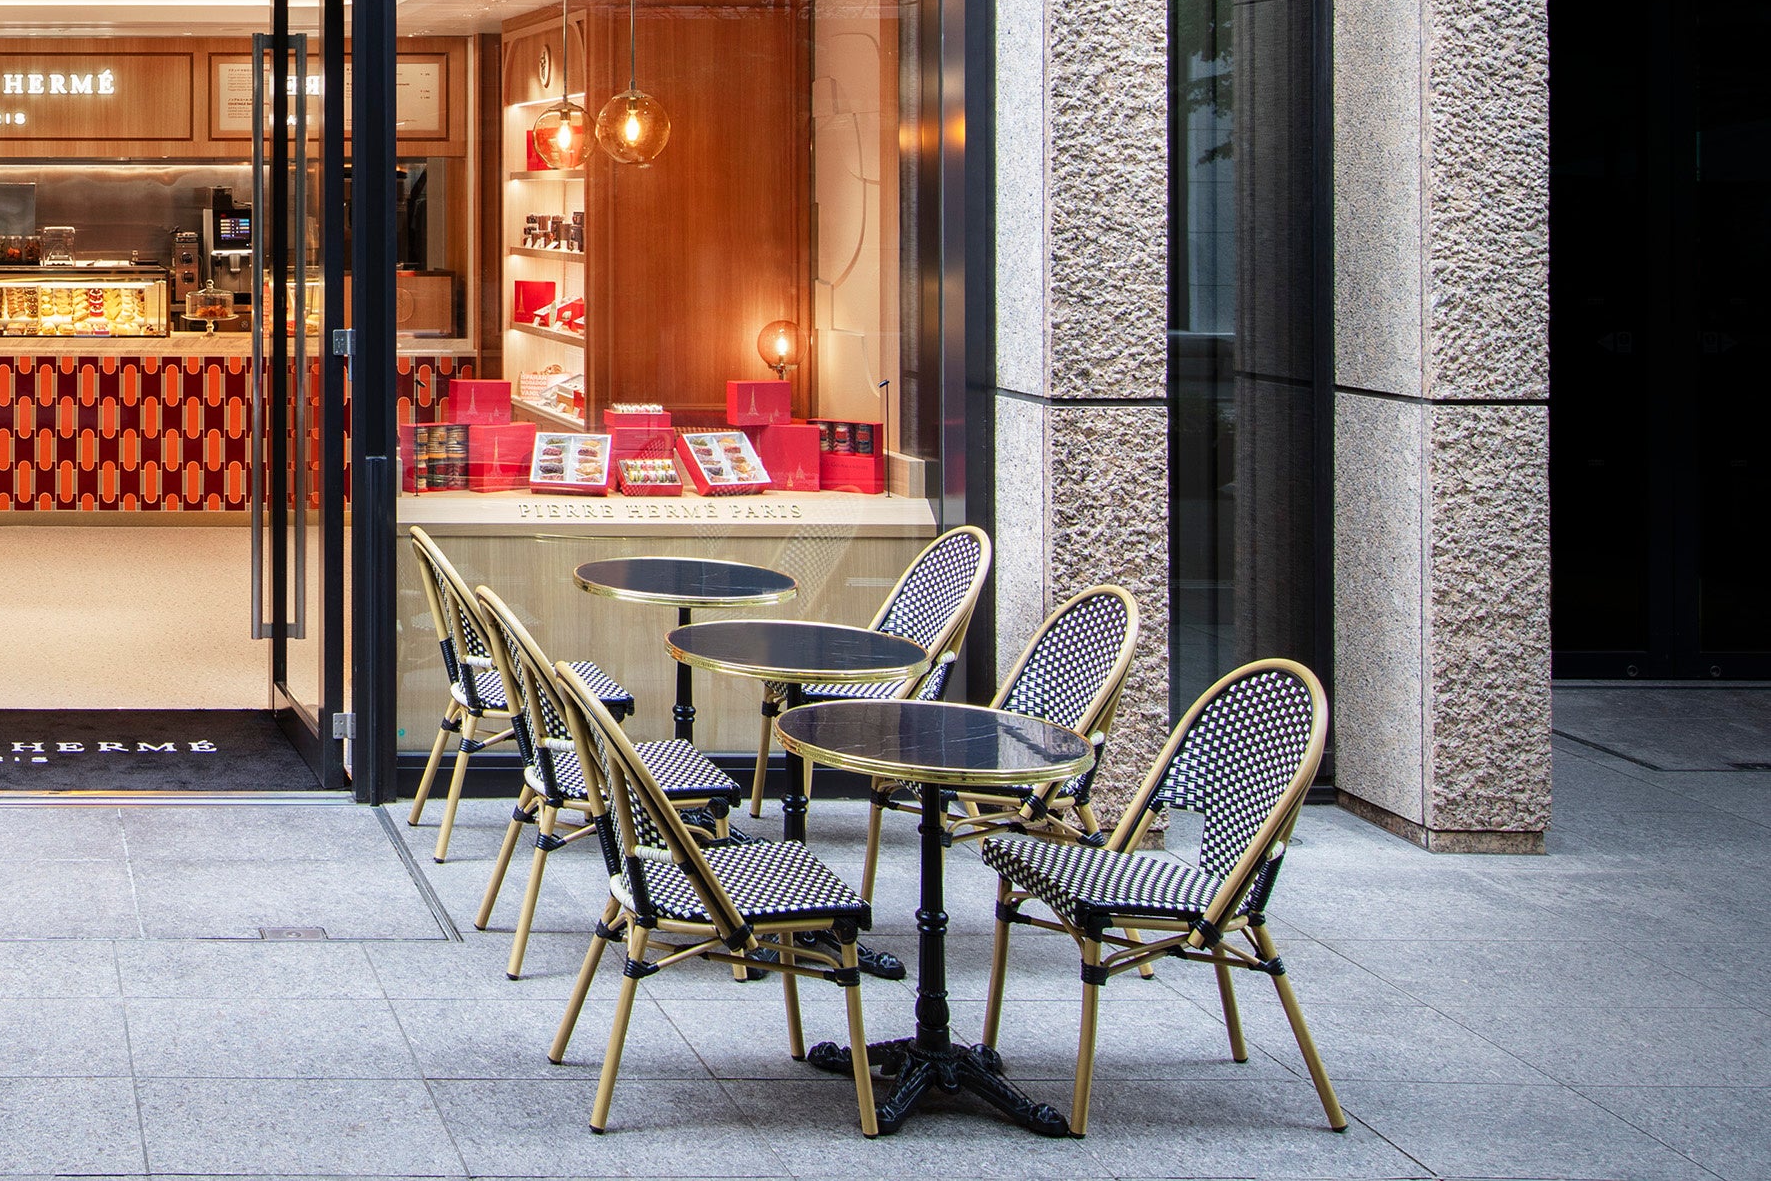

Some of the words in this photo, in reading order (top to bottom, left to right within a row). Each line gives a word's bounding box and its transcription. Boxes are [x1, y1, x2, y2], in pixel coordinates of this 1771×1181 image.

[3, 69, 115, 94] HERMÉ
[518, 504, 614, 518] PIERRE
[626, 502, 718, 518] HERMÉ
[728, 504, 803, 518] PARIS
[11, 739, 217, 753] HERMÉ
